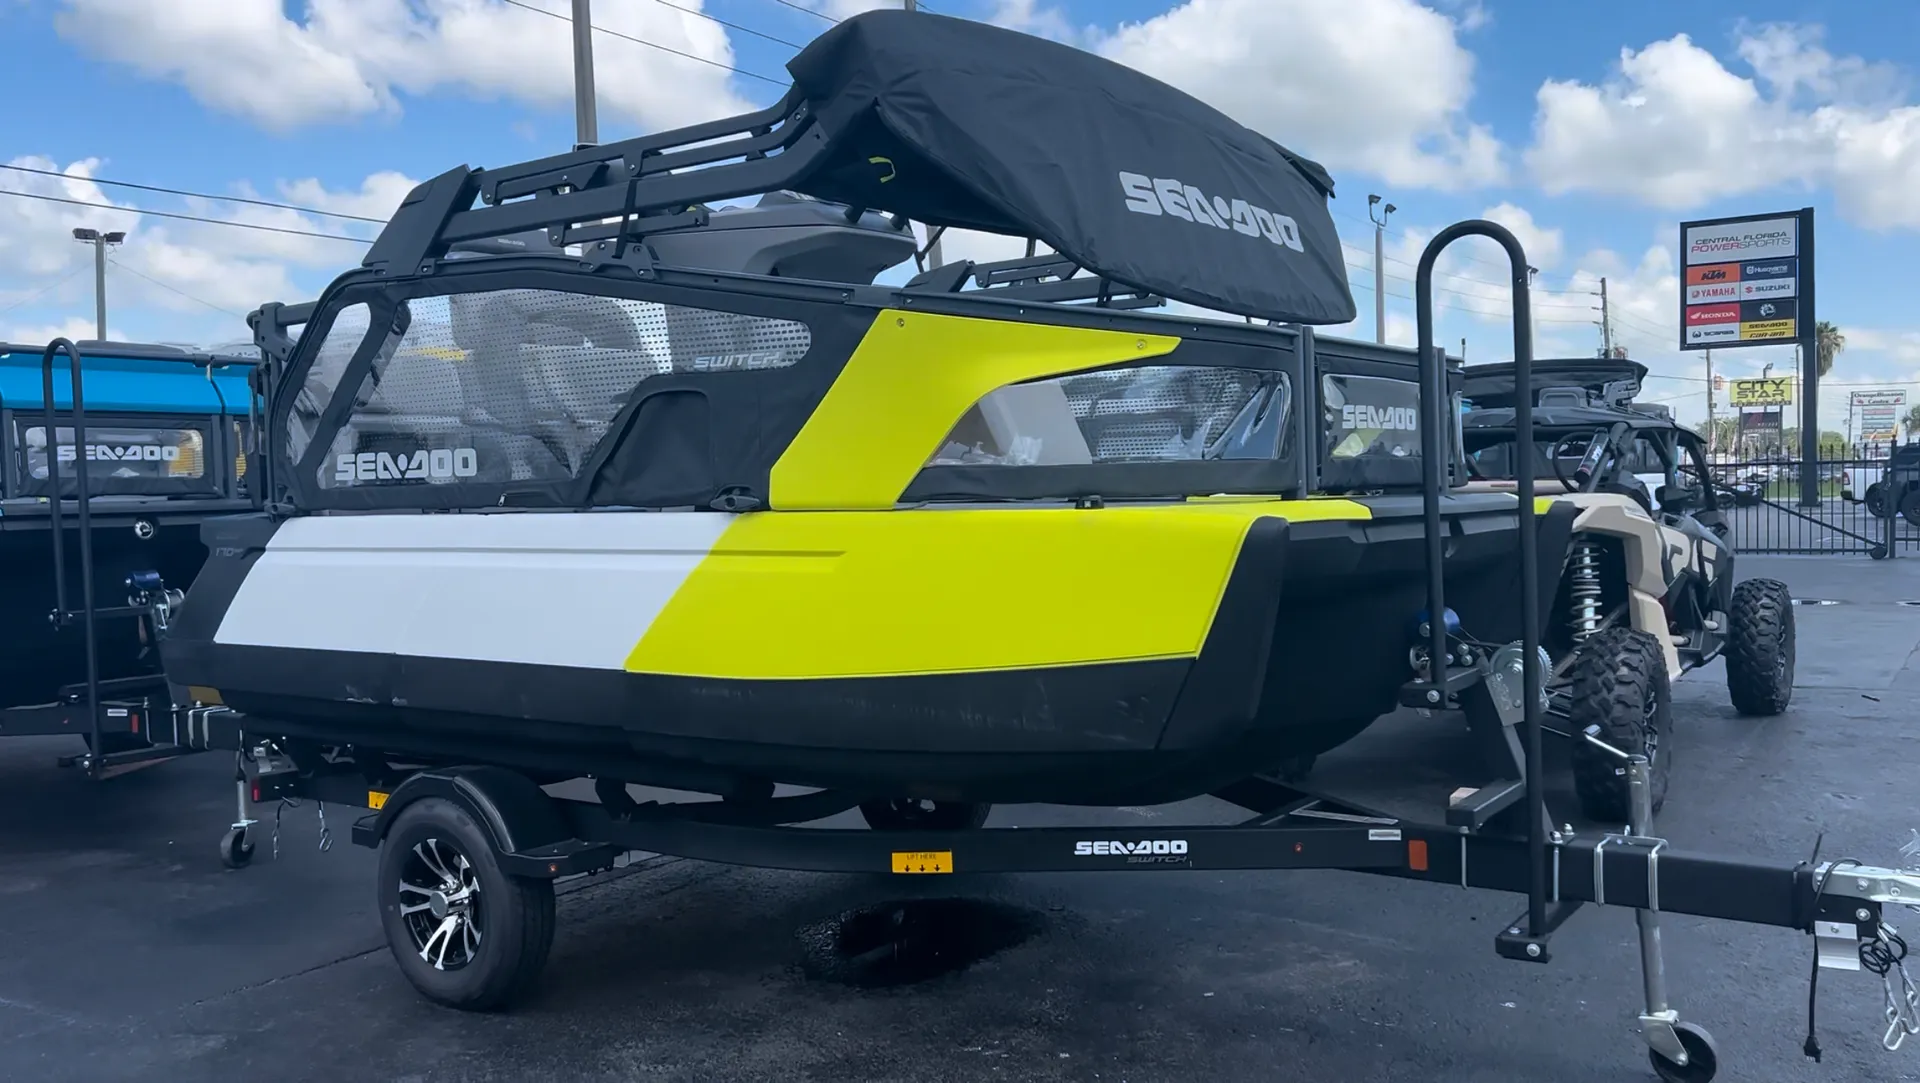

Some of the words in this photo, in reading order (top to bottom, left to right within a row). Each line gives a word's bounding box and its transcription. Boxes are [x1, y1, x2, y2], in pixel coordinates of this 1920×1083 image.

[1695, 235, 1741, 246] CENTRAL
[1743, 231, 1787, 241] FLORIDA
[1691, 237, 1791, 253] POWERSPORTS
[1701, 269, 1726, 281] KTM
[1701, 287, 1736, 297] YAMAHA
[1755, 284, 1790, 292] SUZUKI
[1701, 311, 1736, 320] HONDA
[694, 352, 781, 370] SWITCH
[1737, 379, 1785, 391] CITY
[1737, 390, 1785, 399] STAR
[1126, 855, 1187, 864] SWITCH
